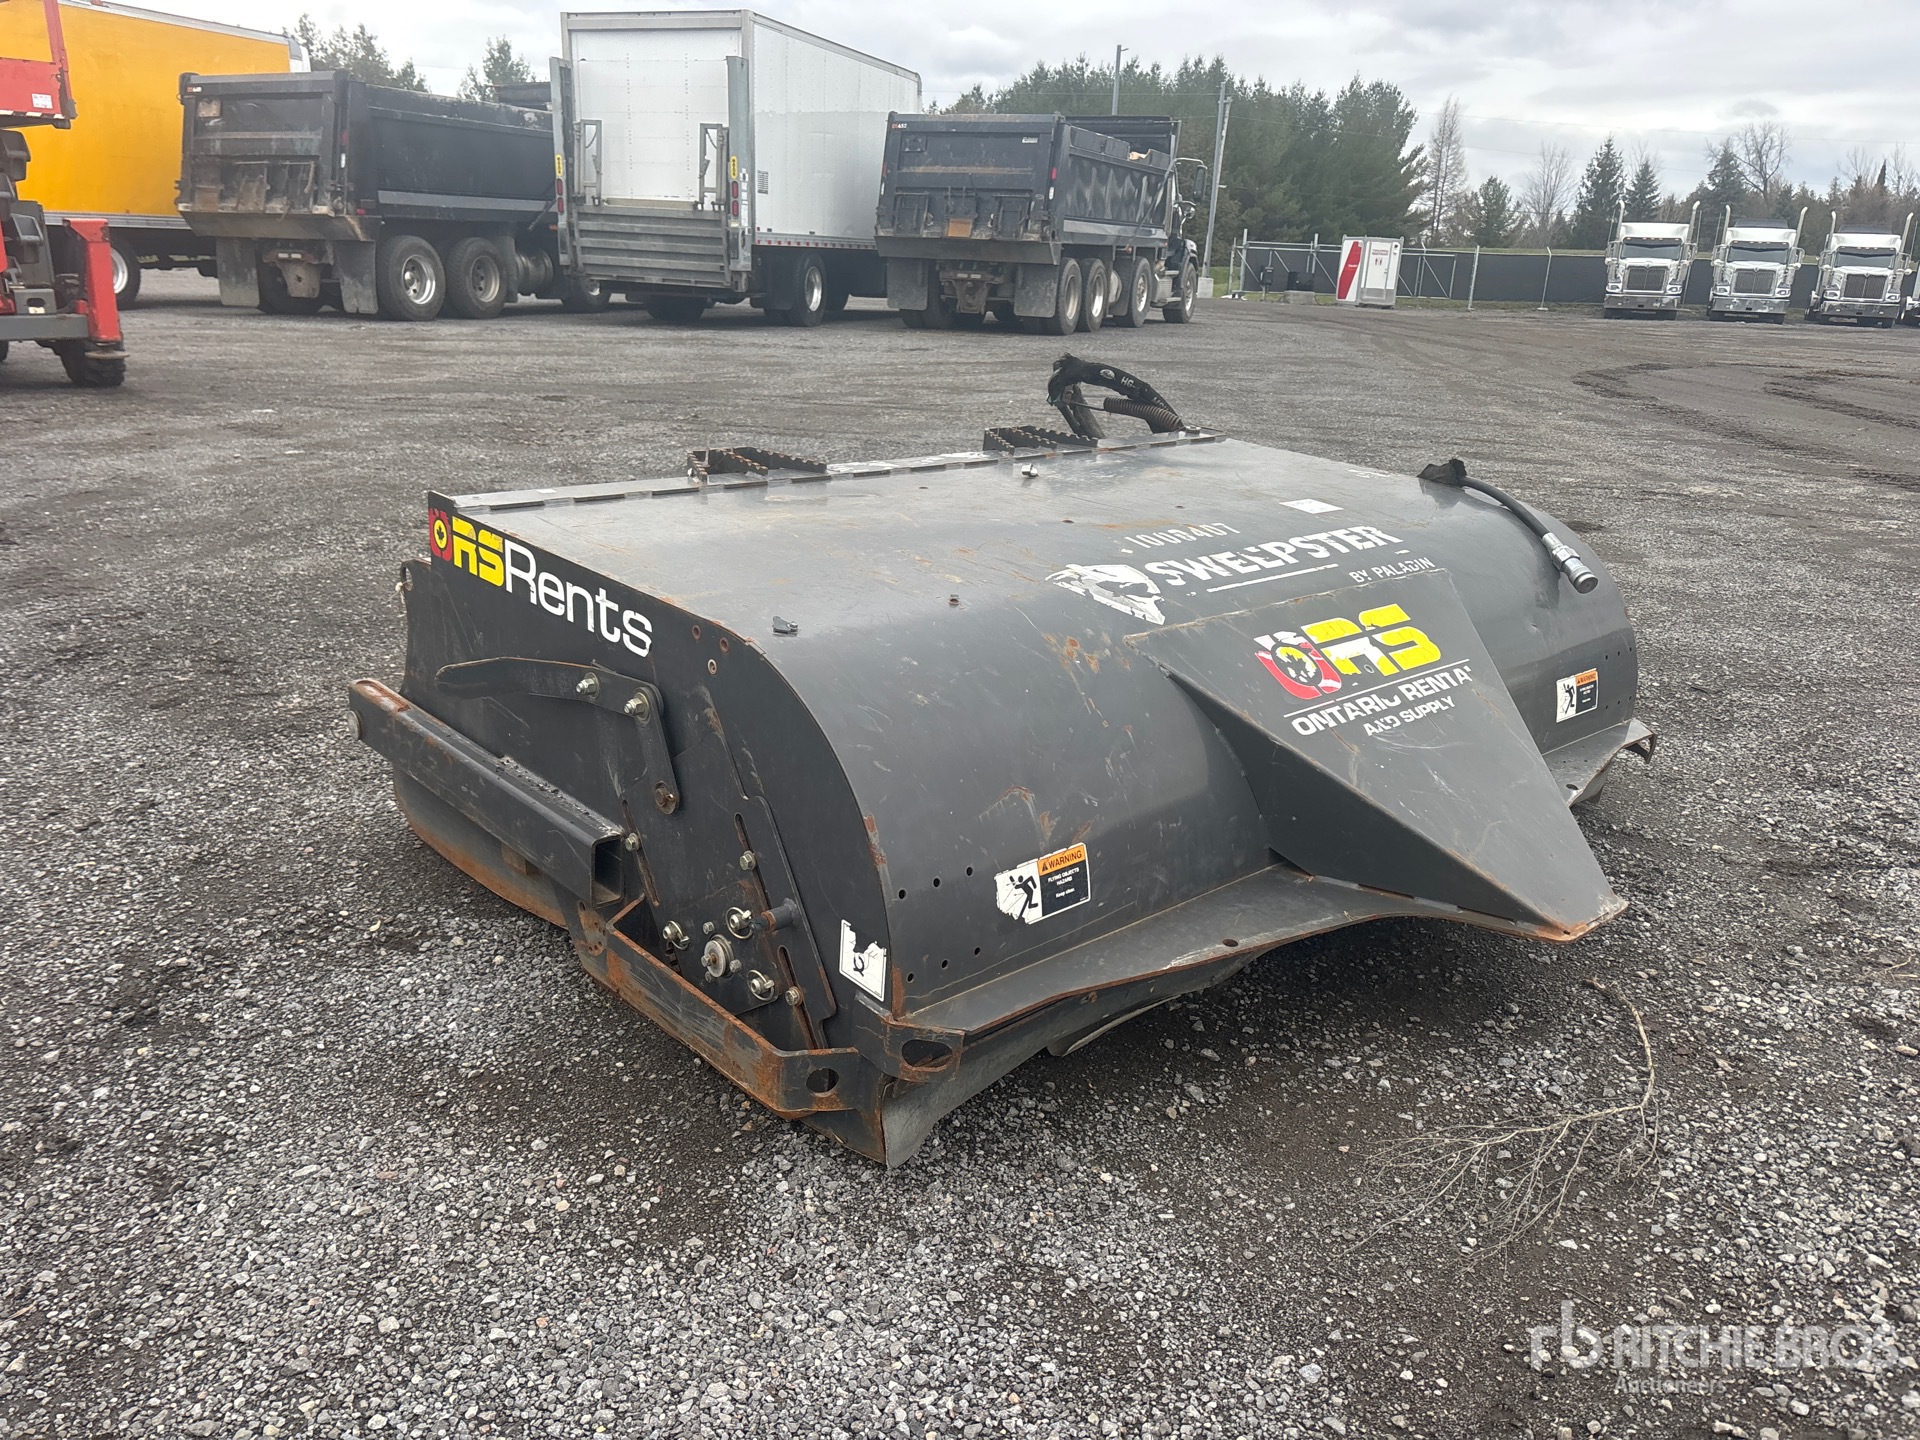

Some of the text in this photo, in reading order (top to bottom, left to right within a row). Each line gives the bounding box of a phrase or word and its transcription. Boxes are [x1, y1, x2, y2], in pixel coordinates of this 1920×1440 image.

[1144, 525, 1405, 586] SWEEPSTER
[1348, 557, 1435, 584] BY PALADIN
[503, 538, 653, 658] Rents
[1398, 665, 1473, 701] RENTA
[1401, 695, 1456, 723] SUPPLY
[1048, 850, 1082, 869] WARNING
[1048, 867, 1079, 882] FLYING OBJECTS
[1057, 876, 1072, 886] HAZARD
